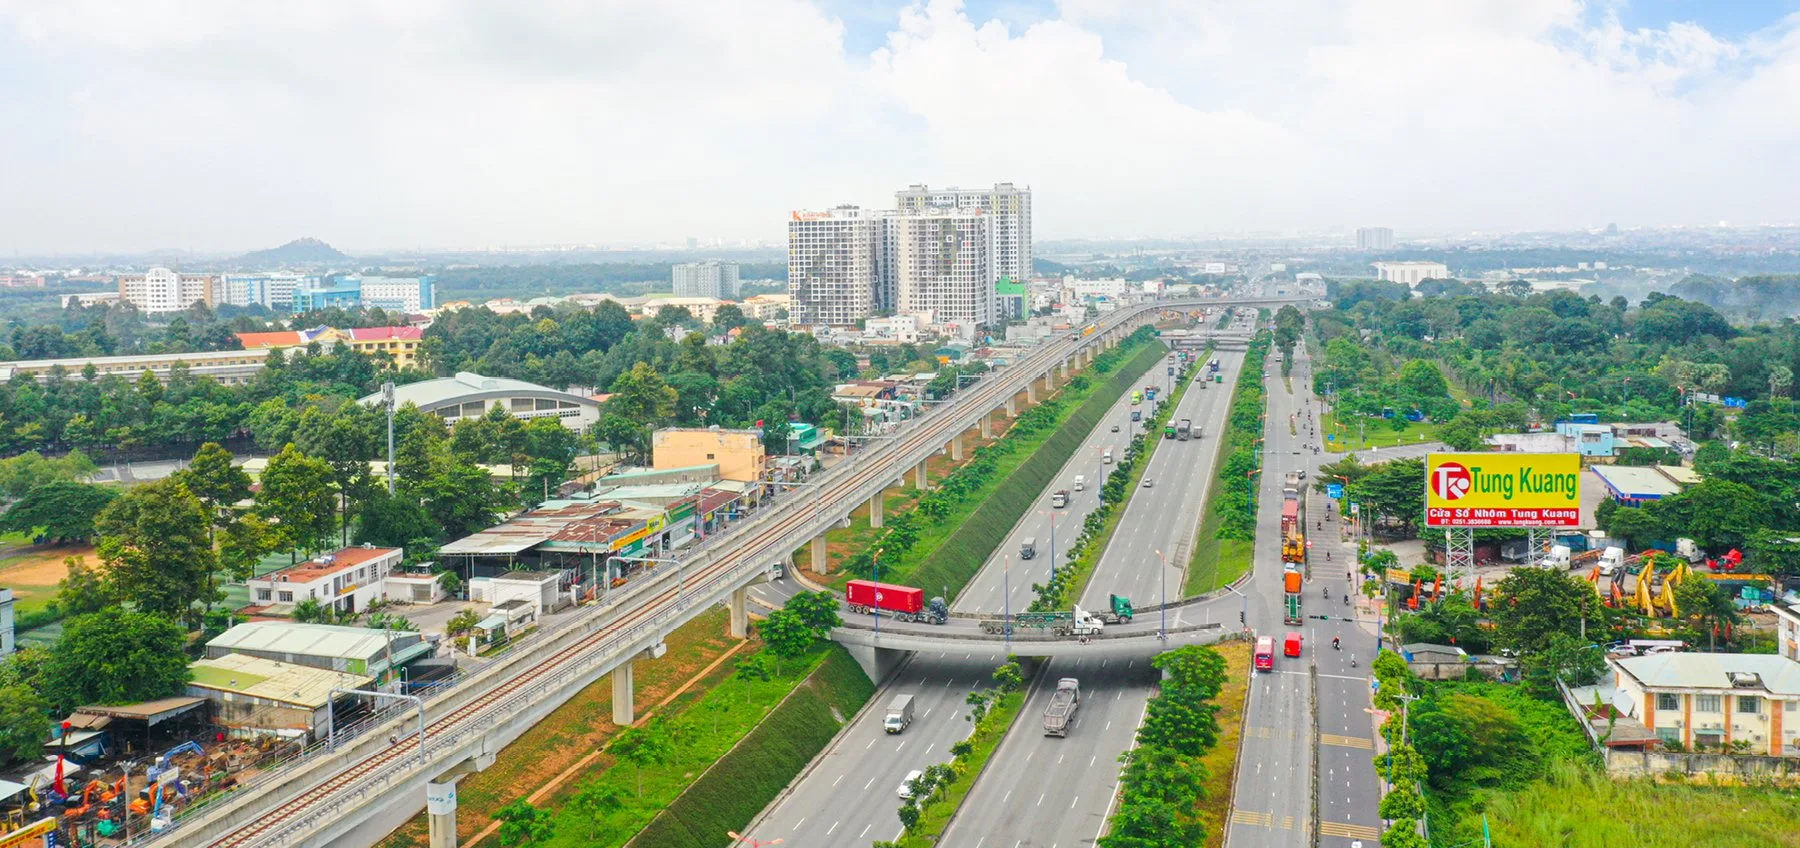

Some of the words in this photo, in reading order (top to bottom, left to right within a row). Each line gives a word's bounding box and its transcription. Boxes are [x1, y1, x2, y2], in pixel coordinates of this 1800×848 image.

[1471, 467, 1513, 500] Tung
[1520, 467, 1576, 500] Kuang
[1430, 508, 1451, 517] Cửa
[1475, 509, 1507, 517] Nhôm
[1511, 509, 1537, 519] Tung
[1541, 509, 1577, 519] Kuang
